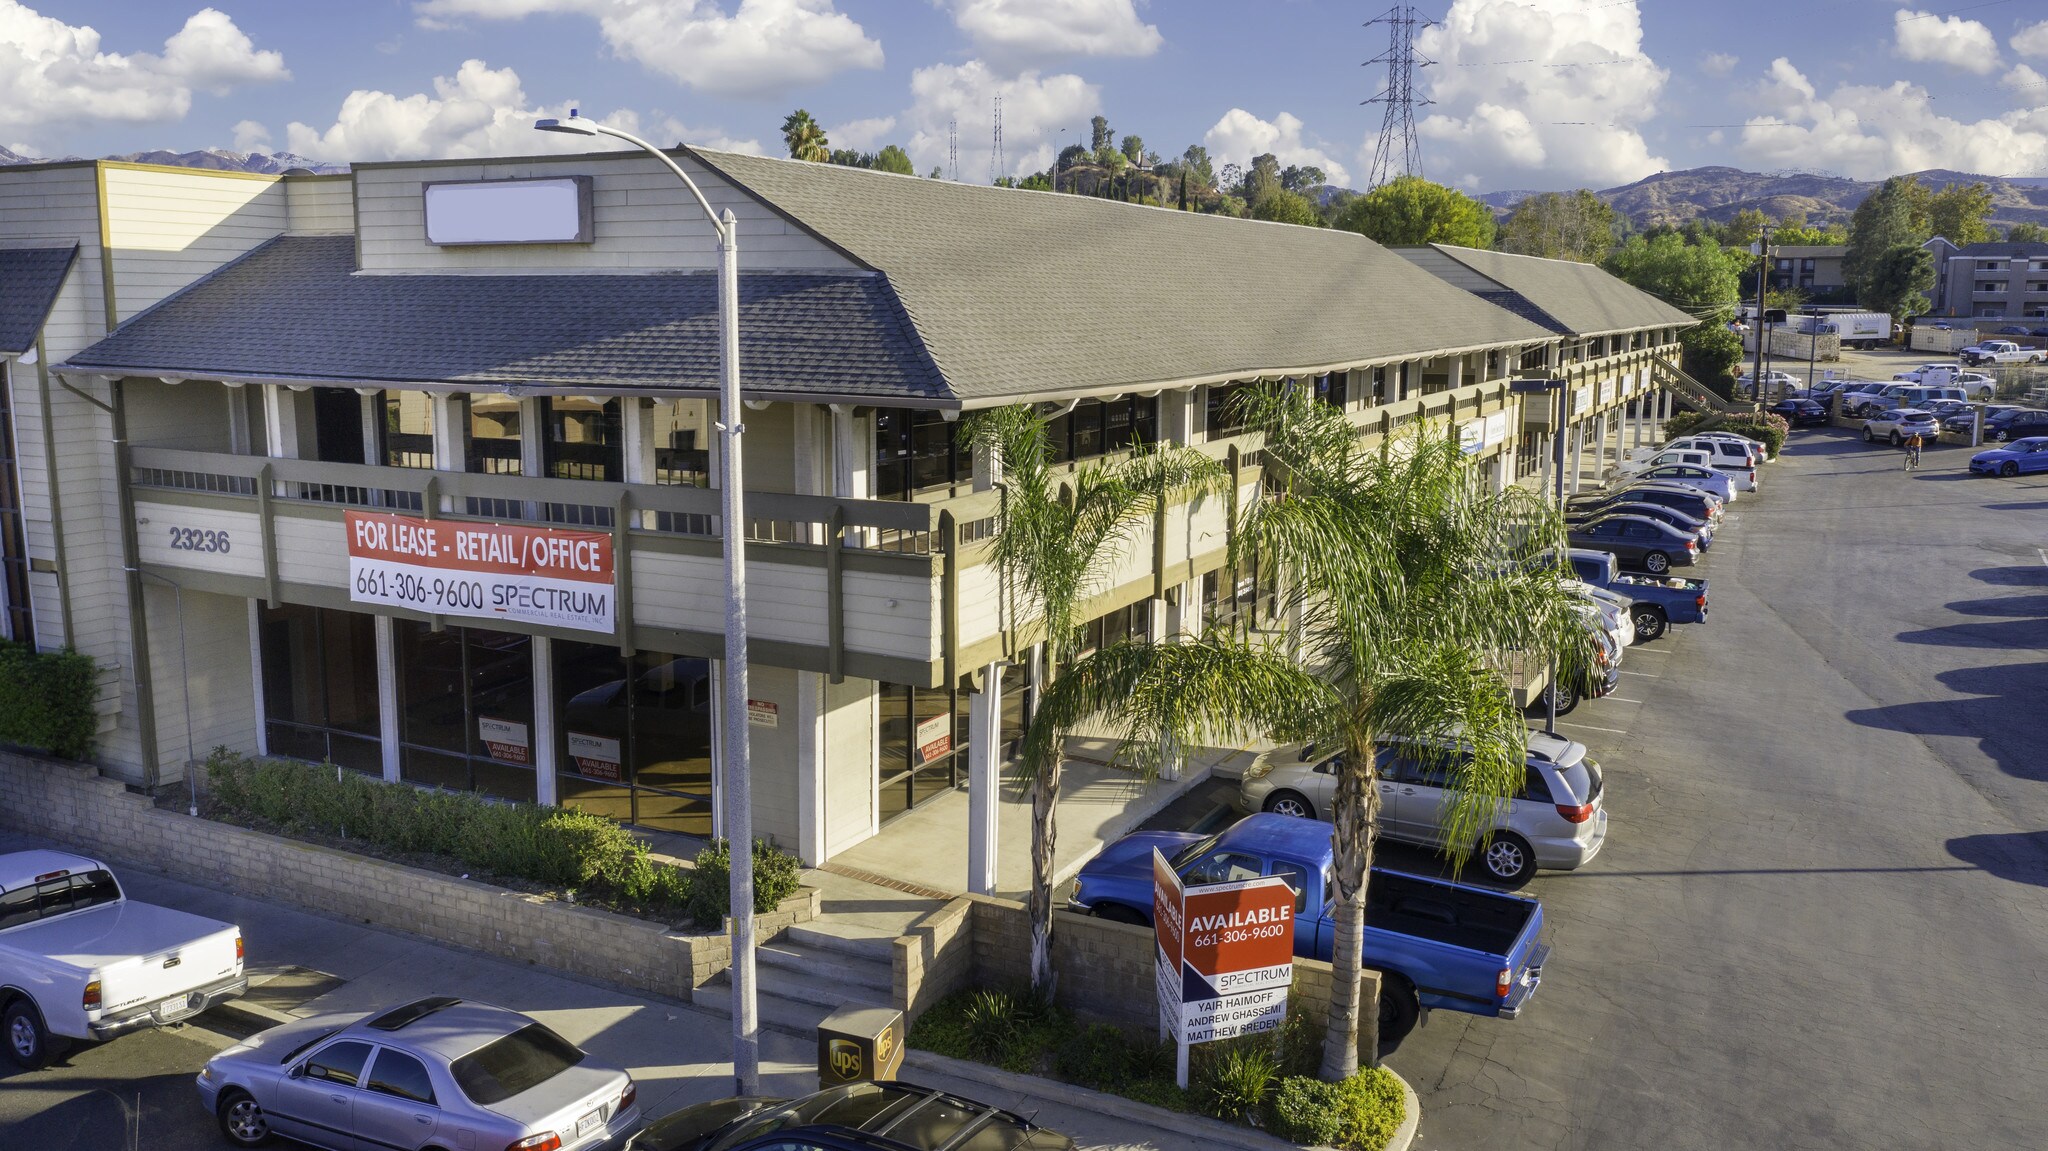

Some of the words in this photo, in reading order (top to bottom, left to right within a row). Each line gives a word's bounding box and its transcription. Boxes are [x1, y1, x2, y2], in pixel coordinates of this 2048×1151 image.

[169, 526, 230, 554] 23236
[355, 519, 388, 551] FOR
[392, 524, 437, 557] LEASE
[456, 531, 519, 564] RETAIL
[532, 537, 601, 572] OFFICE
[356, 567, 483, 610] 661-306-9600
[491, 583, 606, 617] SPECTRUM
[491, 743, 525, 756] AVAILABLE
[925, 738, 948, 752] AVAILABLE
[581, 760, 617, 771] AVAILABLE
[1189, 905, 1291, 933] AVAILABLE
[1194, 924, 1284, 947] 661-306-9600
[1220, 966, 1290, 988] SPECTRUM
[1198, 1000, 1223, 1012] YAIR
[1225, 992, 1274, 1008] HAIMOFF
[1187, 1013, 1230, 1028] ANDREW
[1232, 1004, 1281, 1020] GHASSEMI
[1187, 1025, 1237, 1042] MATTHEW
[833, 1051, 860, 1075] ups
